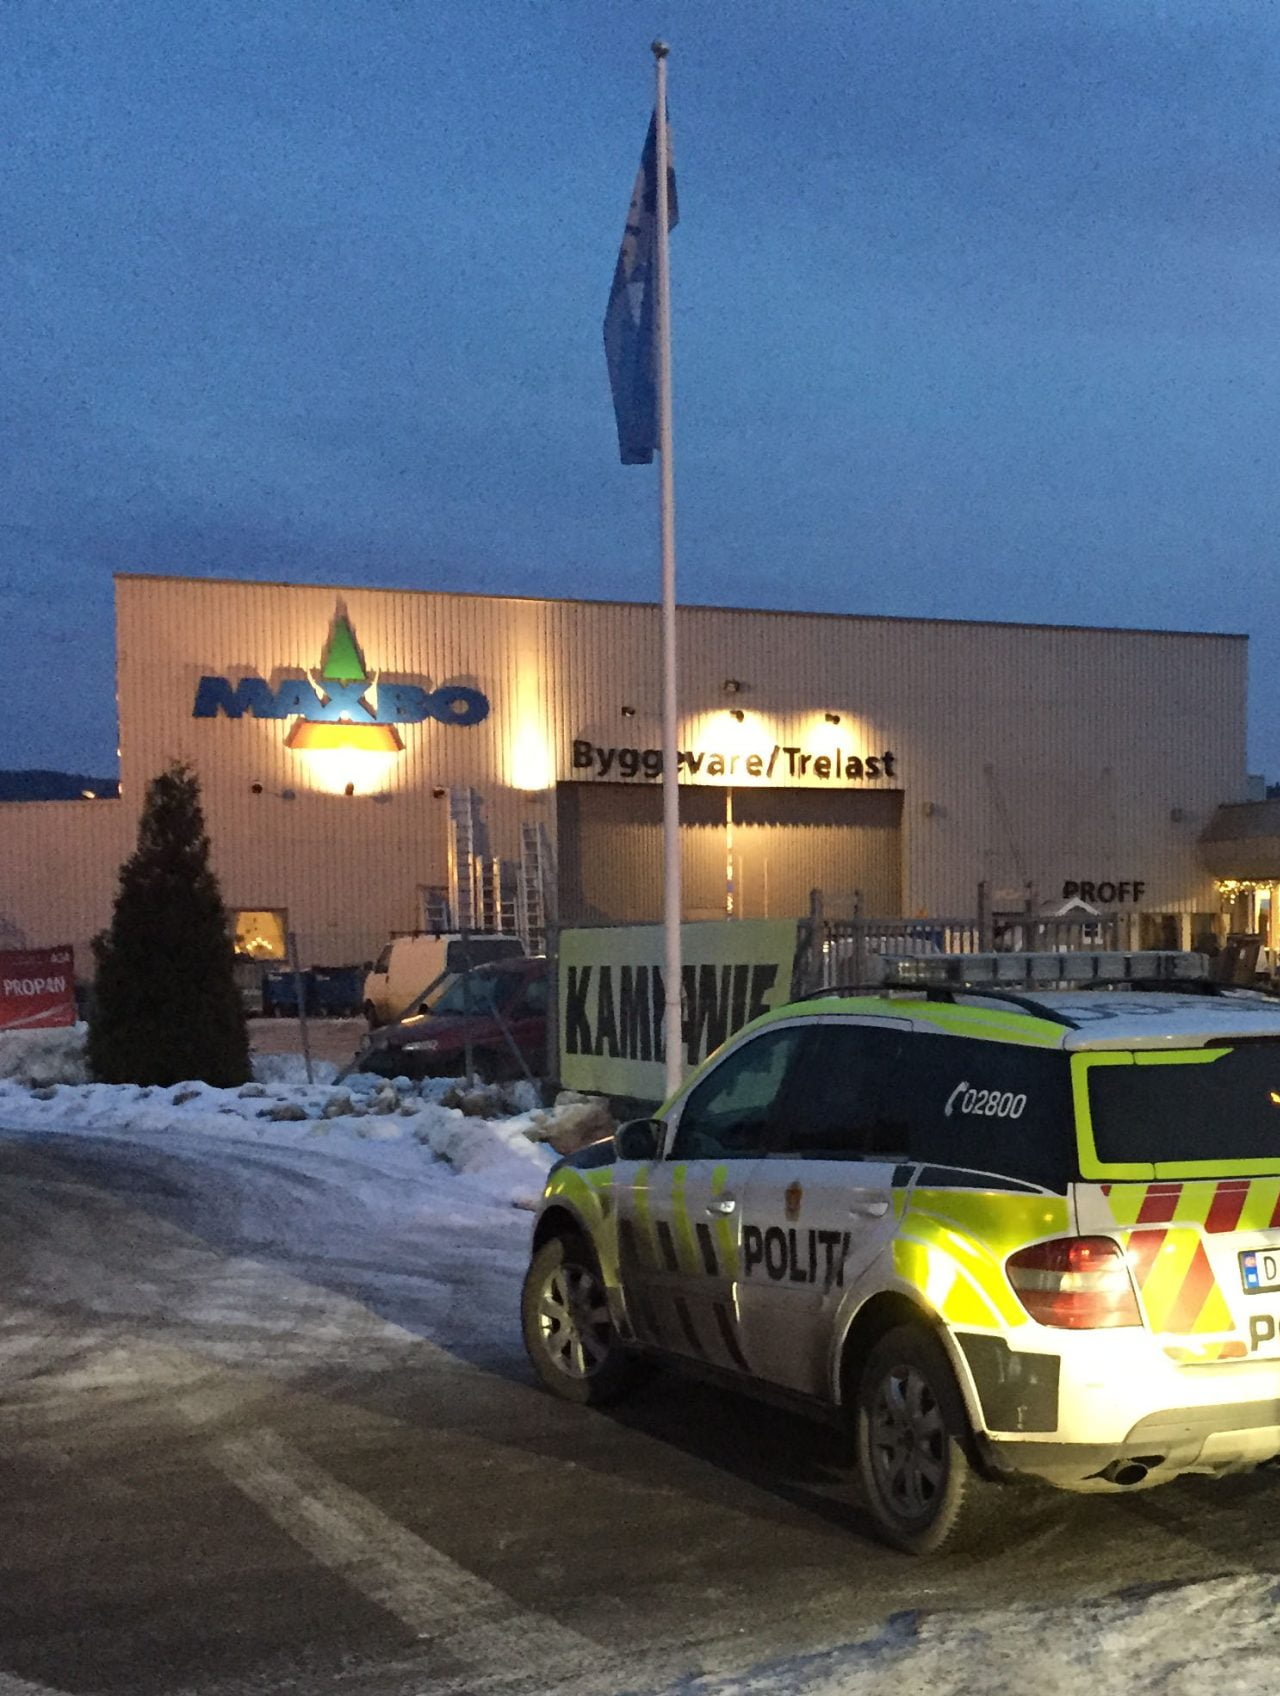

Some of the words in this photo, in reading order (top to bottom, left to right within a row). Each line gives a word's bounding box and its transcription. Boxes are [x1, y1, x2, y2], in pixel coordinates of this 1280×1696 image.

[192, 676, 490, 726] MAXBO
[1062, 881, 1145, 902] PROFF
[3, 976, 66, 996] PROPAN
[962, 1089, 1027, 1119] 02800
[743, 1225, 851, 1289] POLITI
